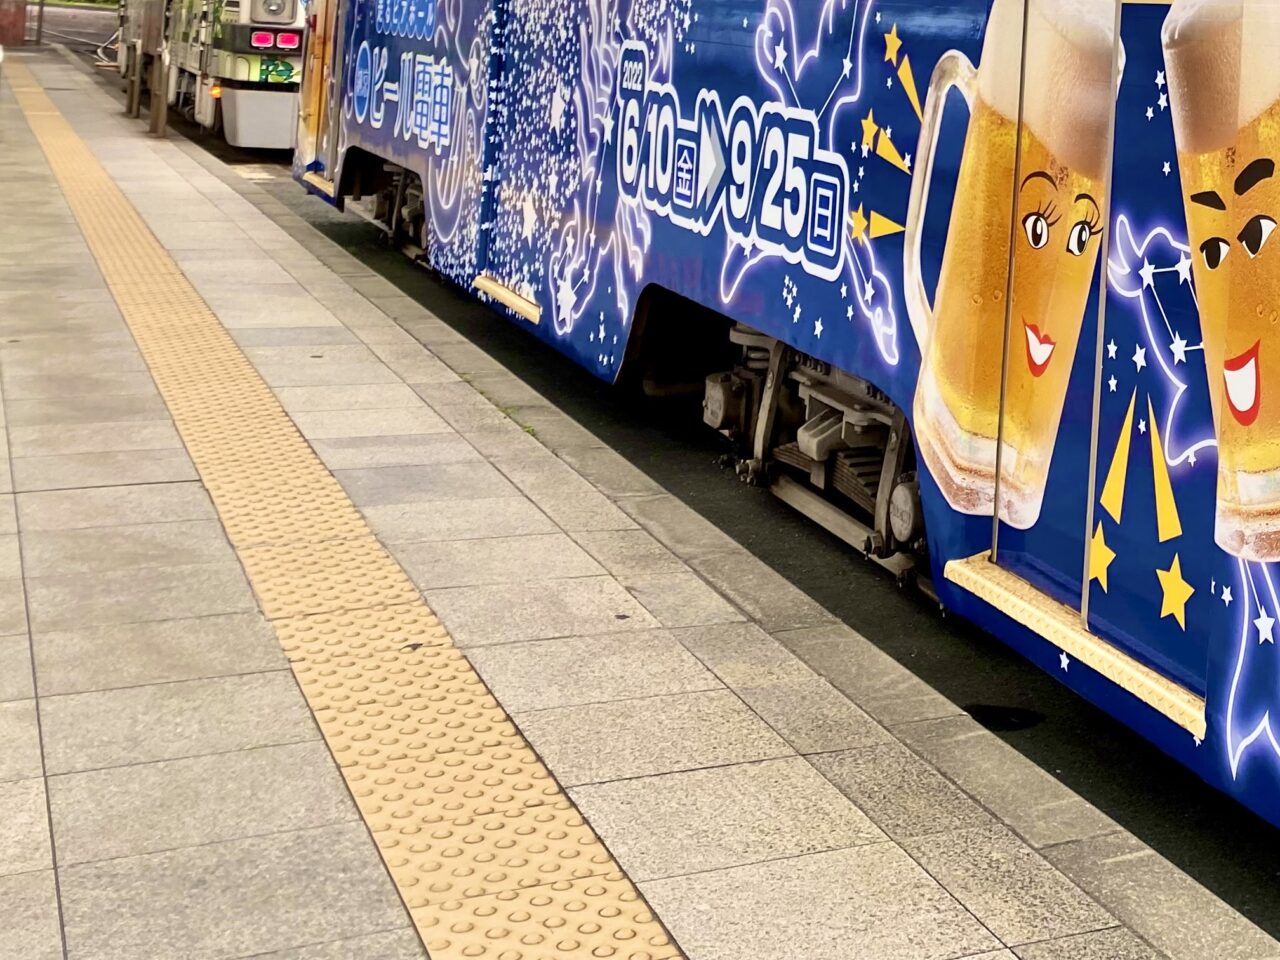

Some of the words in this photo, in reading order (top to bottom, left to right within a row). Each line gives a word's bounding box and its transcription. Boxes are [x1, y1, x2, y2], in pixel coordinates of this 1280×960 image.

[370, 46, 453, 156] ビール電車
[622, 60, 643, 91] 2022
